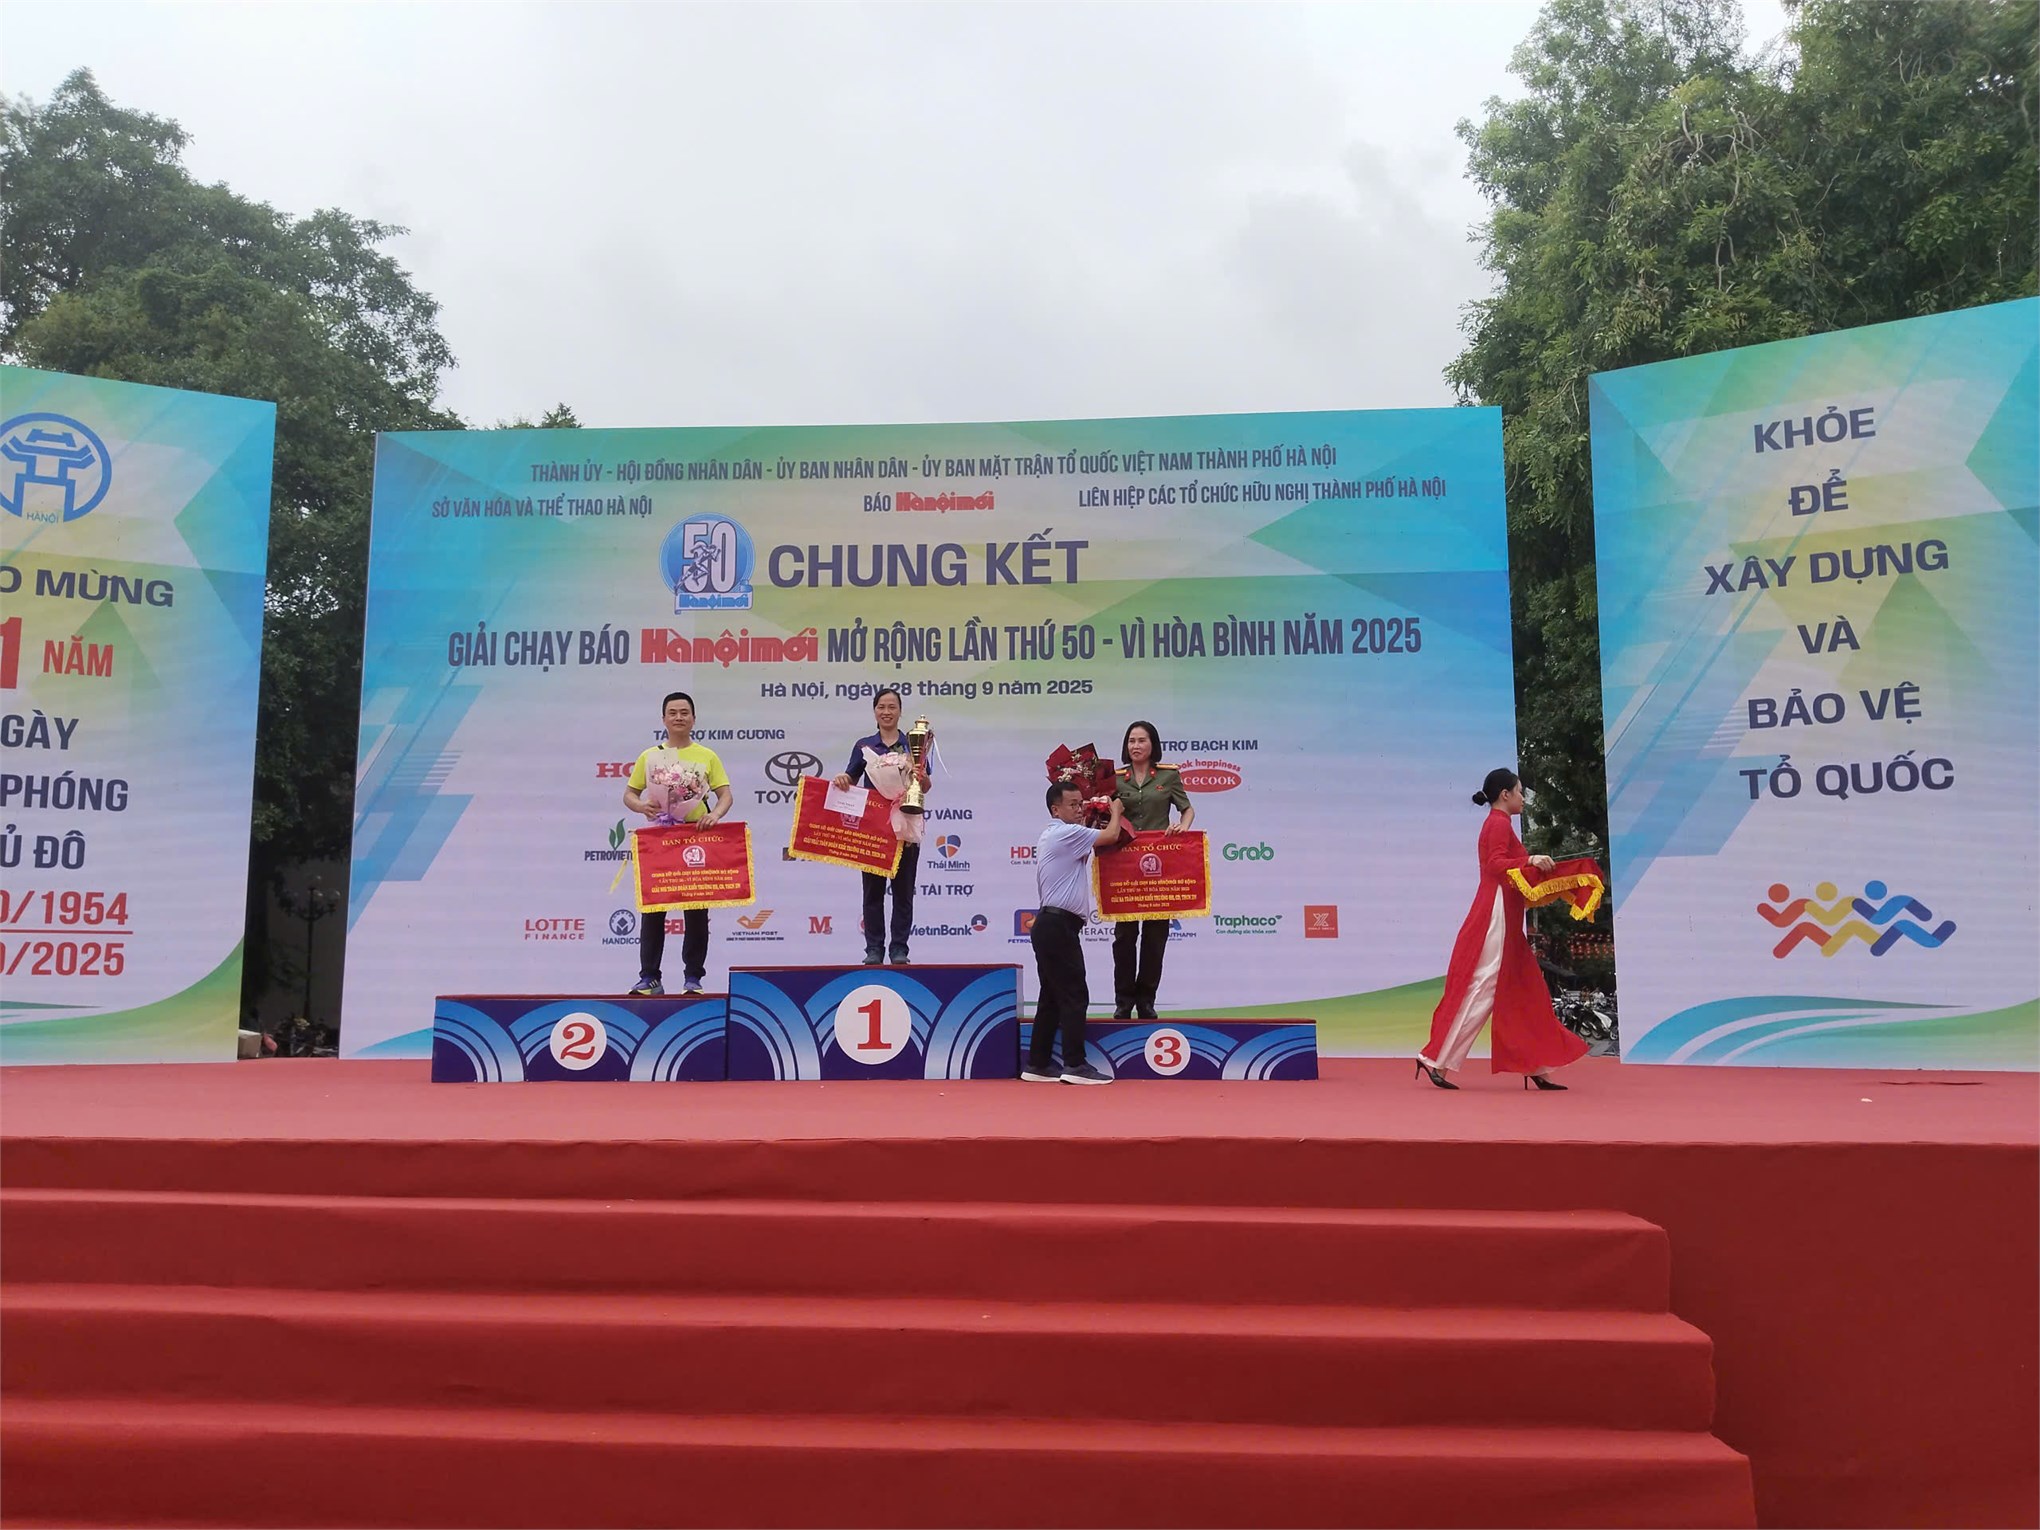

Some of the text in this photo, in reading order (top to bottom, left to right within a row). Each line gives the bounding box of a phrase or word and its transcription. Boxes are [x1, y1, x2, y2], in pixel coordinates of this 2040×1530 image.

[1754, 405, 1876, 453] KHỎE
[531, 460, 579, 482] THÀNH
[584, 458, 602, 481] ỦY
[617, 459, 641, 485] HỘI
[645, 457, 684, 481] ĐỒNG
[688, 458, 728, 480] NHÂN
[733, 458, 762, 480] DÂN
[776, 455, 796, 480] ỦY
[800, 461, 829, 480] BAN
[833, 457, 874, 479] NHÂN
[879, 456, 908, 478] DÂN
[922, 454, 942, 477] ỦY
[945, 459, 975, 477] BAN
[979, 454, 1010, 480] MẶT
[1015, 452, 1053, 478] TRẬN
[1057, 448, 1077, 474] TỔ
[1080, 449, 1118, 474] QUỐC
[1122, 450, 1155, 475] VIỆT
[1159, 452, 1192, 471] NAM
[1197, 446, 1247, 470] THÀNH
[1253, 444, 1284, 468] PHỐ
[1287, 445, 1307, 467] HÀ
[1311, 443, 1336, 470] NỘI
[432, 492, 652, 519] SỞ VĂN HÓA VÀ THỂ THAO HÀ NỘI
[864, 491, 891, 512] BÁO
[1079, 475, 1446, 508] LIÊN HIỆP CÁC TỔ CHỨC HỮU NGHỊ THÀNH PHỐ HÀ NỘI
[1788, 469, 1848, 516] ĐỂ
[682, 521, 737, 594] 50
[768, 527, 1089, 588] CHUNG KẾT
[1704, 539, 1949, 595] XÂY DỰNG
[35, 568, 174, 608] MỪNG
[448, 621, 497, 666] GIẢI
[504, 629, 573, 673] CHẠY
[578, 623, 630, 665] BÁO
[640, 627, 819, 668] Hànộimới
[827, 616, 868, 663] MỞ
[874, 620, 941, 669] RỘNG
[949, 616, 998, 661] LẦN
[1004, 618, 1055, 661] THỨ
[1062, 624, 1095, 660] 50
[1120, 616, 1145, 659] VÌ
[1153, 616, 1206, 658] HÒA
[1213, 614, 1275, 657] BÌNH
[1283, 612, 1343, 656] NĂM
[1351, 617, 1422, 655] 2025
[1797, 615, 1861, 654] VÀ
[43, 634, 114, 678] NĂM
[760, 682, 786, 698] Hà
[791, 680, 829, 700] Nội,
[890, 681, 912, 696] 28
[916, 680, 977, 700] tháng
[982, 681, 994, 696] 9
[998, 679, 1042, 696] năm
[1046, 679, 1093, 695] 2025
[1748, 681, 1922, 729] BẢO VỆ
[708, 729, 733, 740] KIM
[1160, 739, 1258, 753] TRỢ BẠCH KIM
[1195, 758, 1241, 772] happiness
[1739, 750, 1954, 801] TỔ QUỐC
[0, 770, 129, 812] PHÓNG
[935, 807, 973, 820] VÀNG
[33, 830, 86, 870] ĐÔ
[927, 860, 970, 869] Thái Minh
[1223, 842, 1274, 861] Grab
[920, 883, 941, 896] TÀI
[945, 884, 974, 897] TRỢ
[524, 932, 585, 941] FINANCE
[525, 918, 586, 932] LOTTE
[1213, 915, 1277, 929] Traphaco
[602, 937, 641, 945] HANDICO
[857, 999, 893, 1050] 1
[563, 1024, 596, 1061] 2
[1154, 1036, 1182, 1066] 3
